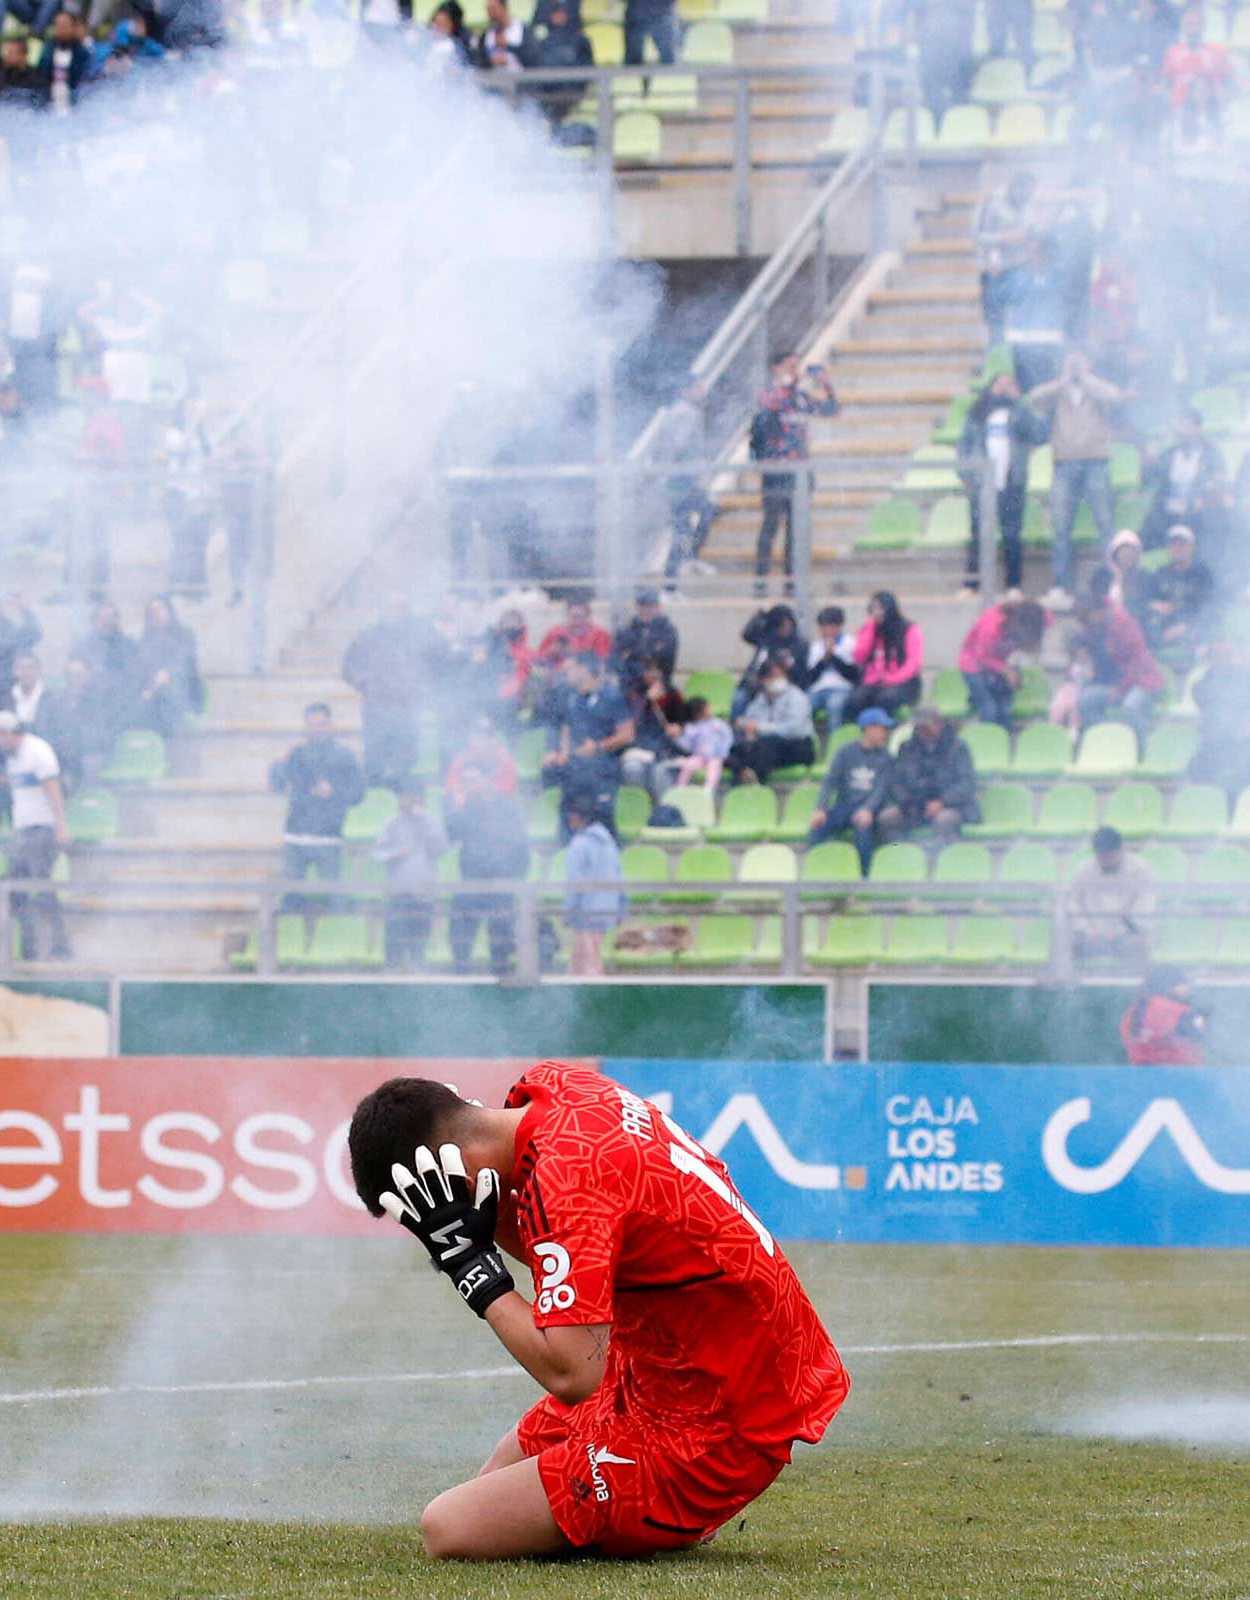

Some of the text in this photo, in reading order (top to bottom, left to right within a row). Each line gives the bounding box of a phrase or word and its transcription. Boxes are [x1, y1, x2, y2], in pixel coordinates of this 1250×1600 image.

[885, 1095, 979, 1126] CAJA
[887, 1128, 957, 1159] LOS
[884, 1161, 1005, 1193] ANDES
